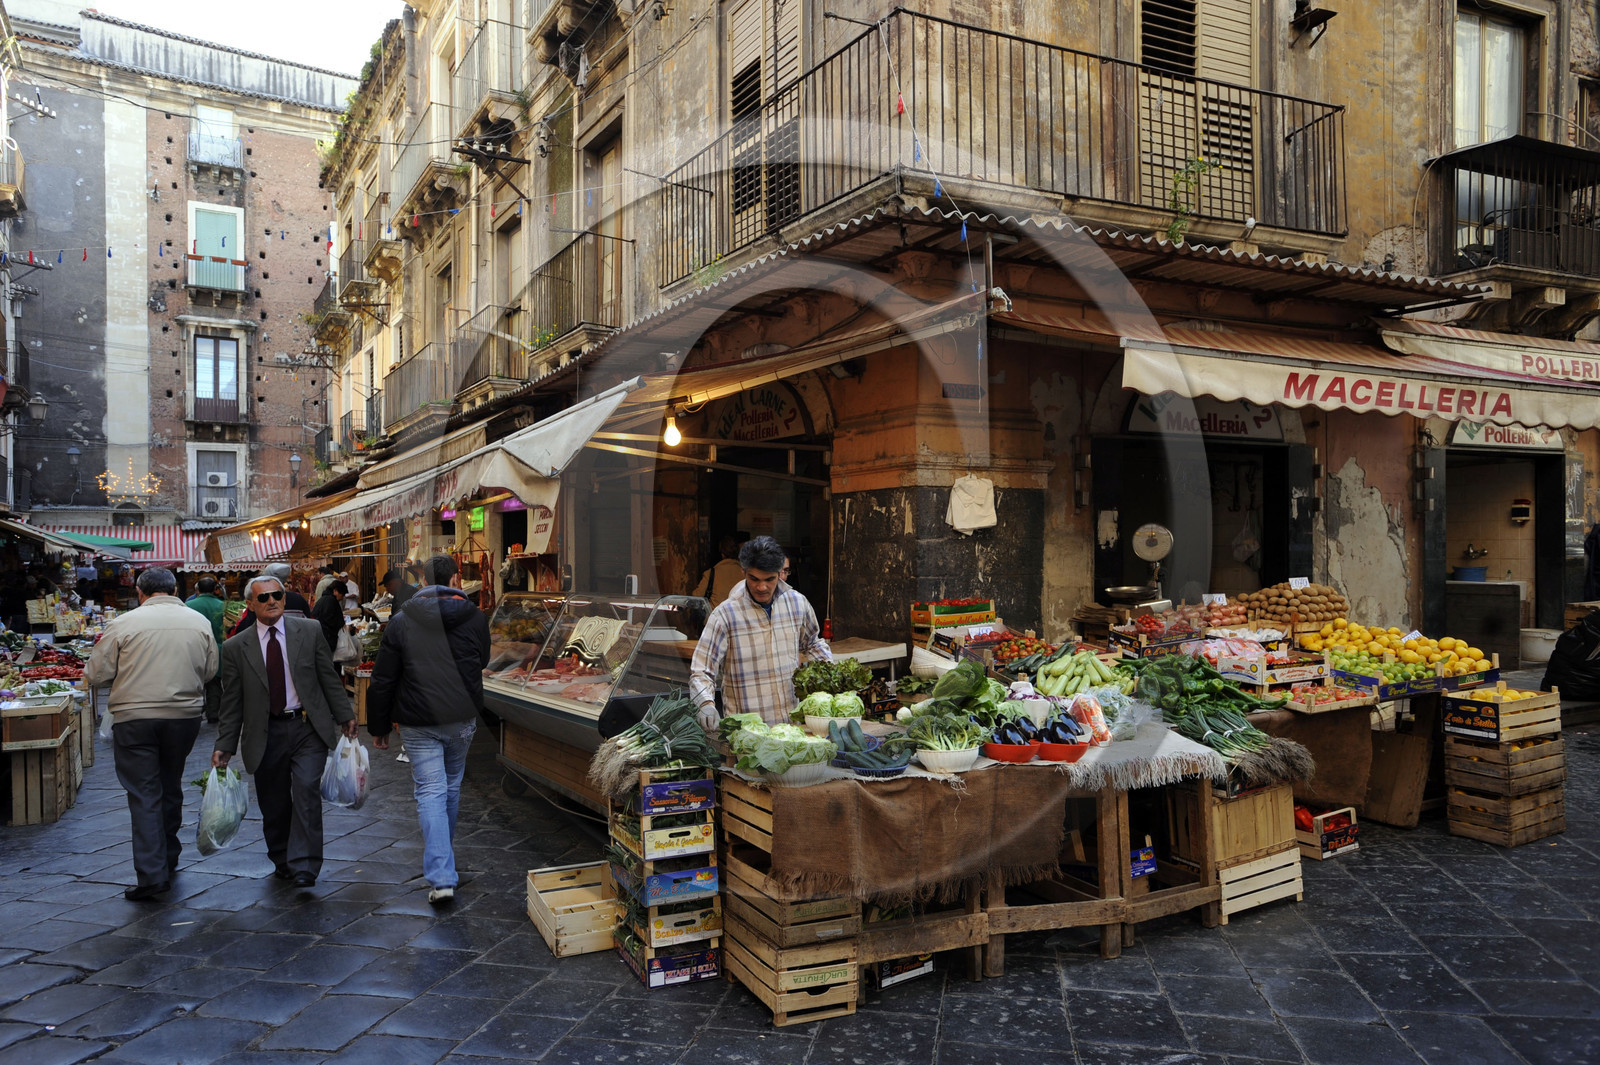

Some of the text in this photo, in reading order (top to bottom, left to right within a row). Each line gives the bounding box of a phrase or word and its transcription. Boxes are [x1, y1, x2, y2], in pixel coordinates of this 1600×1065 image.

[1283, 371, 1513, 418] MACELLERIA
[1472, 716, 1497, 729] Sicilia
[655, 924, 710, 939] Scalzo Mario
